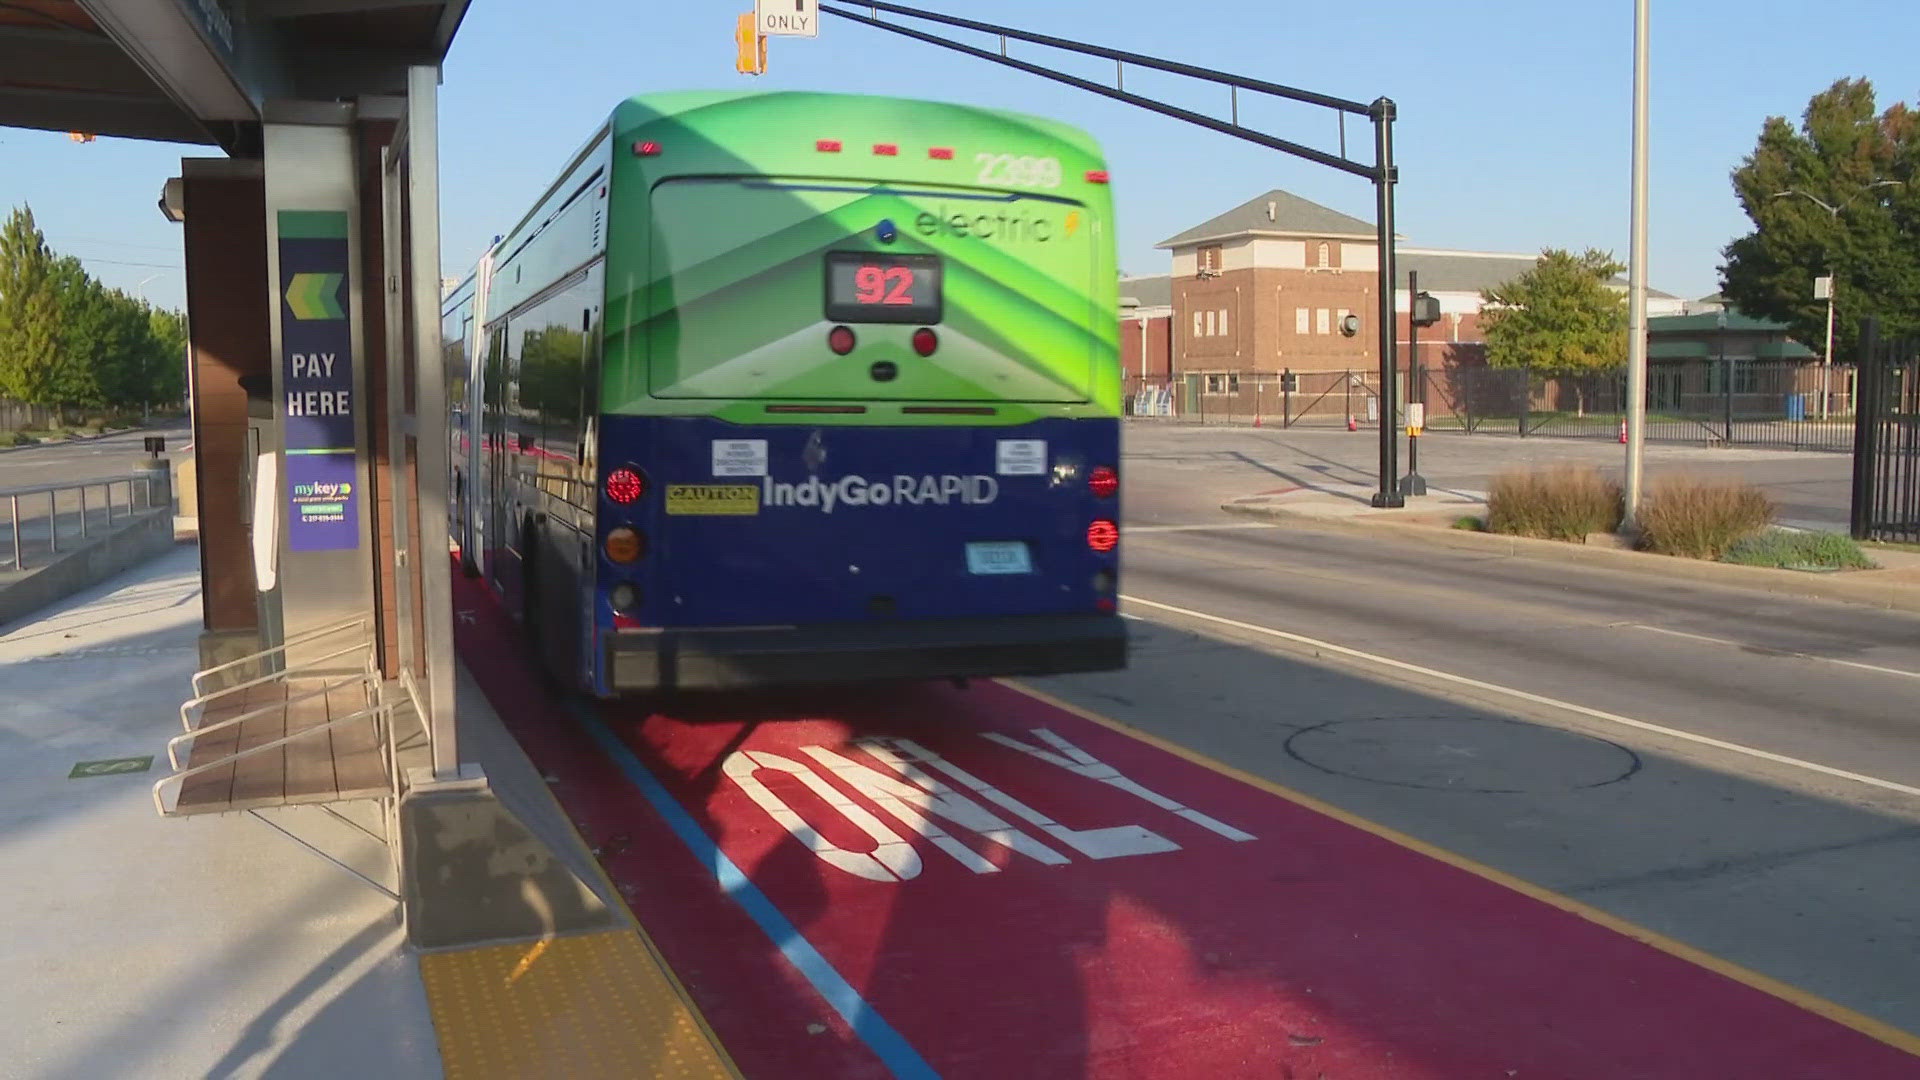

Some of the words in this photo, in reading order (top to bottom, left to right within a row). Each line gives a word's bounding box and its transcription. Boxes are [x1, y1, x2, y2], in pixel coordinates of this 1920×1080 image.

[767, 14, 808, 30] ONLY
[915, 204, 1052, 242] electric
[855, 264, 914, 305] 92
[292, 353, 335, 378] PAY
[288, 391, 350, 416] HERE
[294, 481, 338, 496] mykey
[763, 475, 892, 513] IndyGo
[893, 474, 999, 505] RAPID
[721, 727, 1260, 882] ONLY
